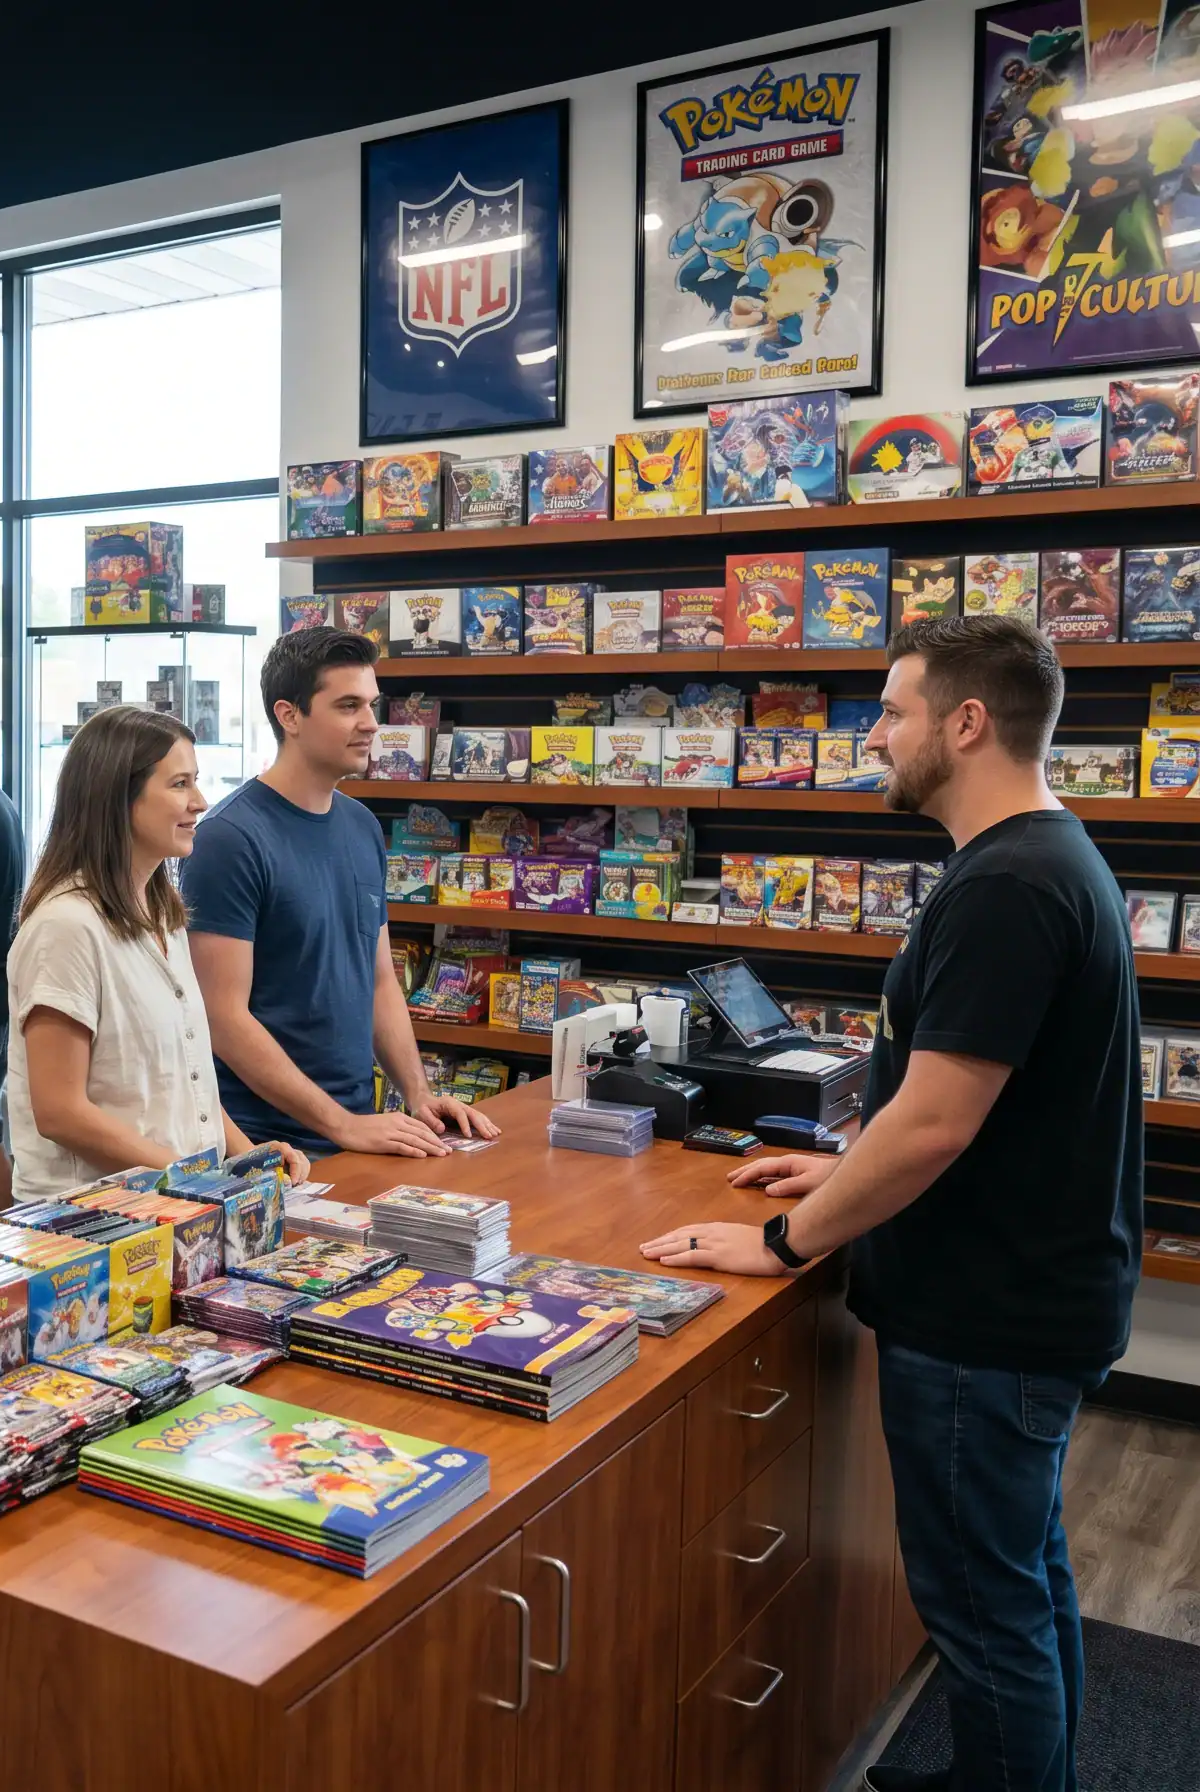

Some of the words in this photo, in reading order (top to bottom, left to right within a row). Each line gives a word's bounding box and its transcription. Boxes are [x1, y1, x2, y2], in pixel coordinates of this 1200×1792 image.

[695, 153, 748, 175] TRADING
[752, 146, 787, 165] CARD
[790, 138, 828, 158] GAME
[411, 252, 508, 327] NFL
[991, 290, 1055, 330] POP
